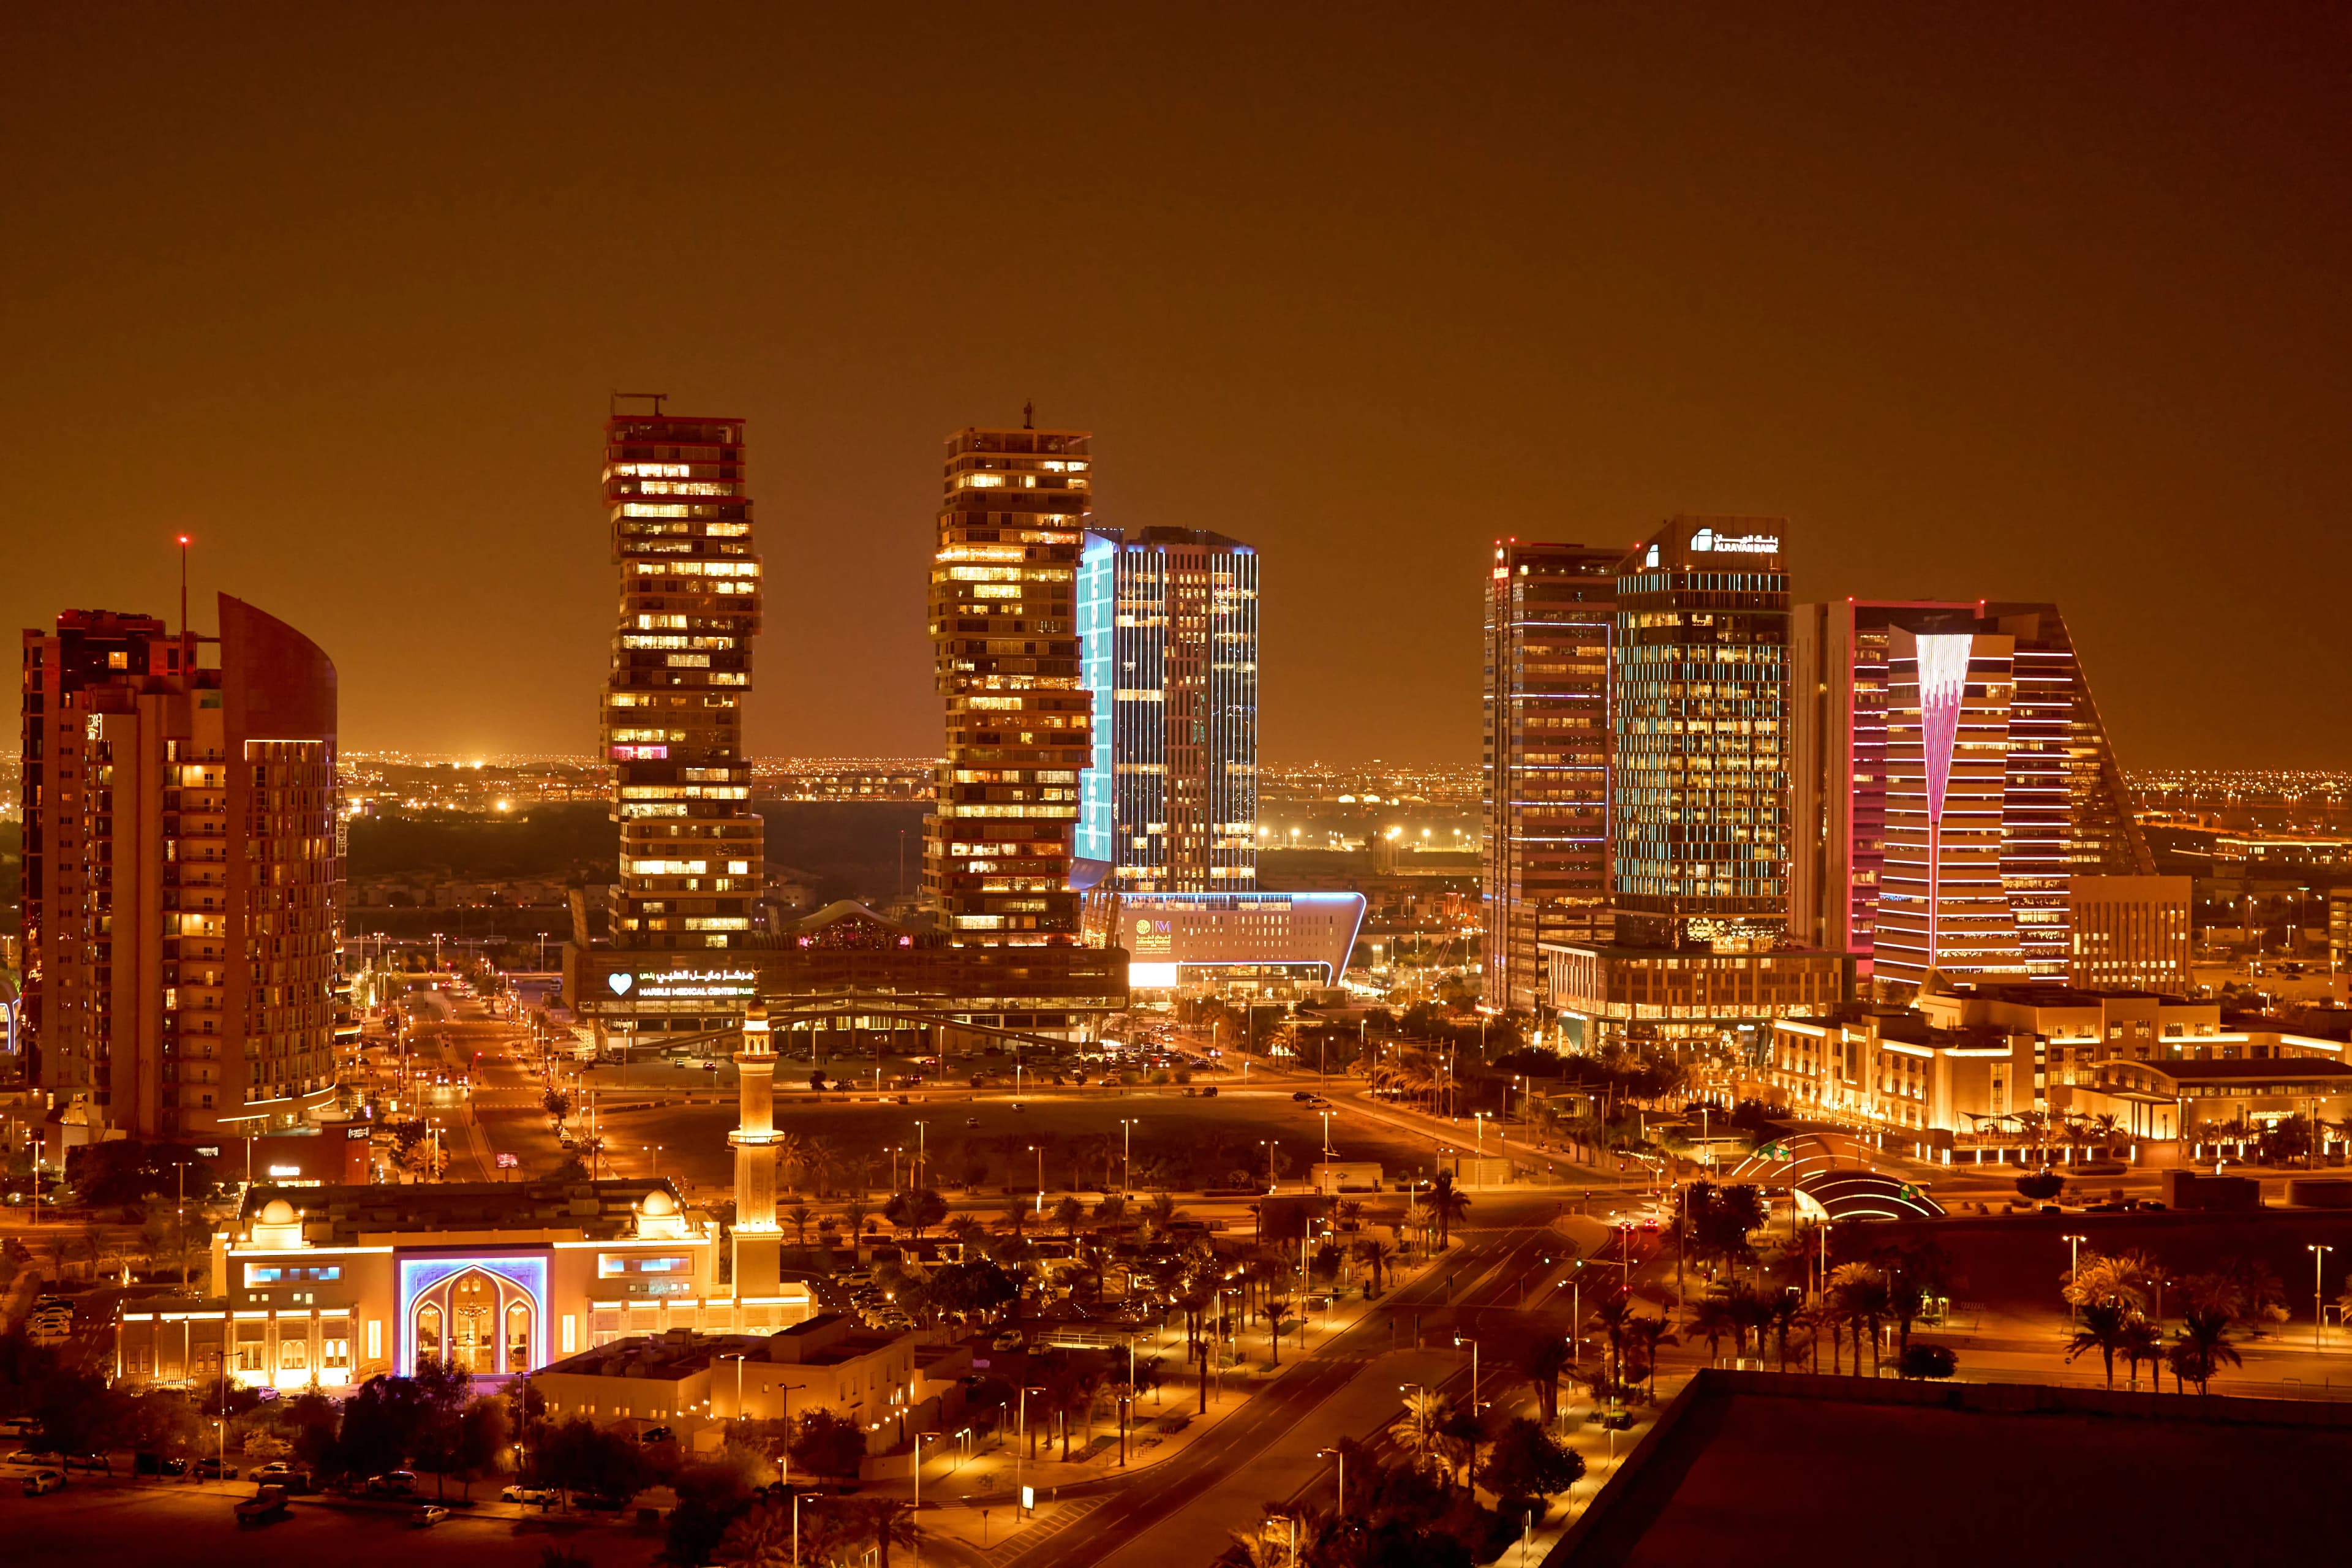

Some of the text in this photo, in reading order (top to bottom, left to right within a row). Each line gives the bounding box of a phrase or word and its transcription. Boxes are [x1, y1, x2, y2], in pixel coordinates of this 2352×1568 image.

[1714, 543, 1778, 552] ALRAYAN BANK
[656, 970, 688, 983] الطبي
[722, 970, 754, 981] مركز
[639, 987, 671, 996] MARBLE
[672, 987, 707, 996] MEDICAL
